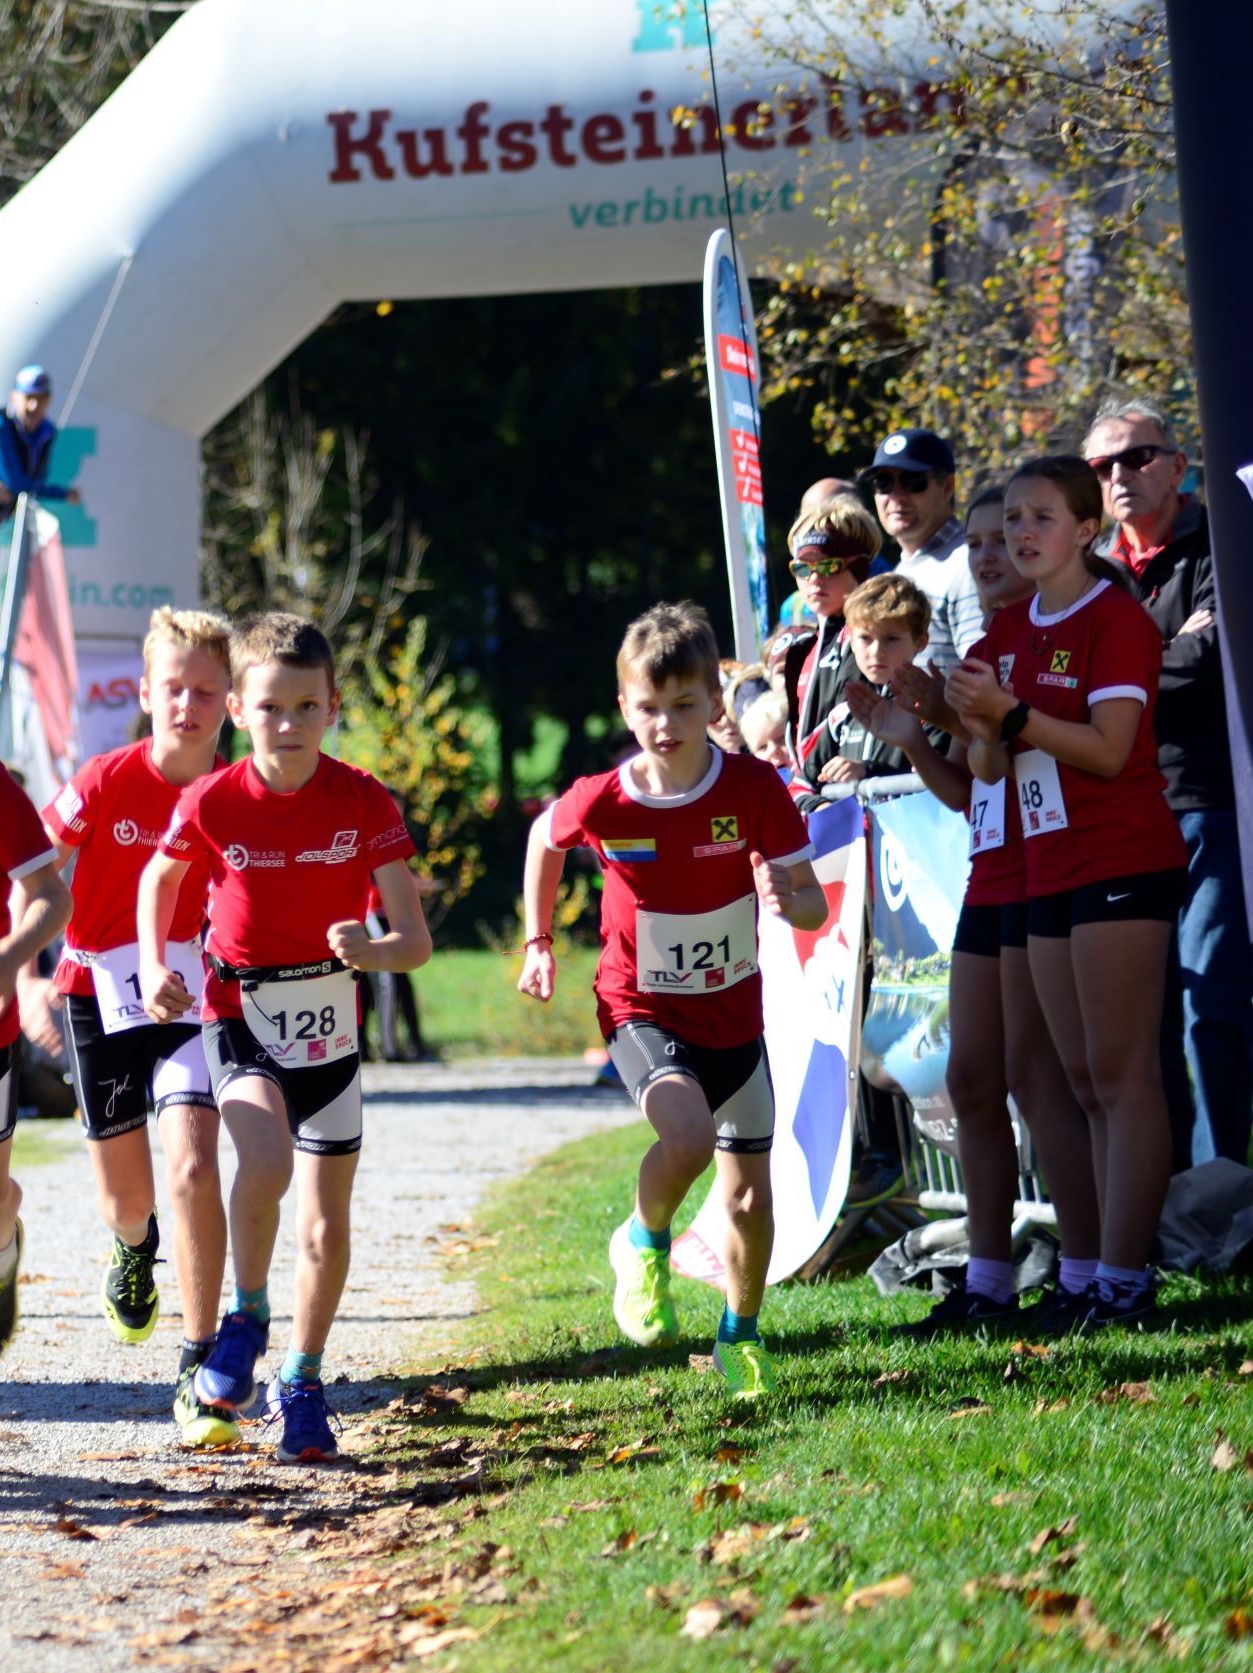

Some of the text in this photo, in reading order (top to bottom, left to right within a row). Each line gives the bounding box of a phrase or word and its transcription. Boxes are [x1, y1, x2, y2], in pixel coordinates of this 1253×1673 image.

[569, 180, 797, 229] verbindet
[704, 842, 738, 854] SPAR
[249, 860, 286, 868] THIERSEE
[668, 934, 731, 971] 121
[278, 965, 322, 978] salomon
[648, 969, 694, 983] TLV
[272, 1005, 336, 1040] 128
